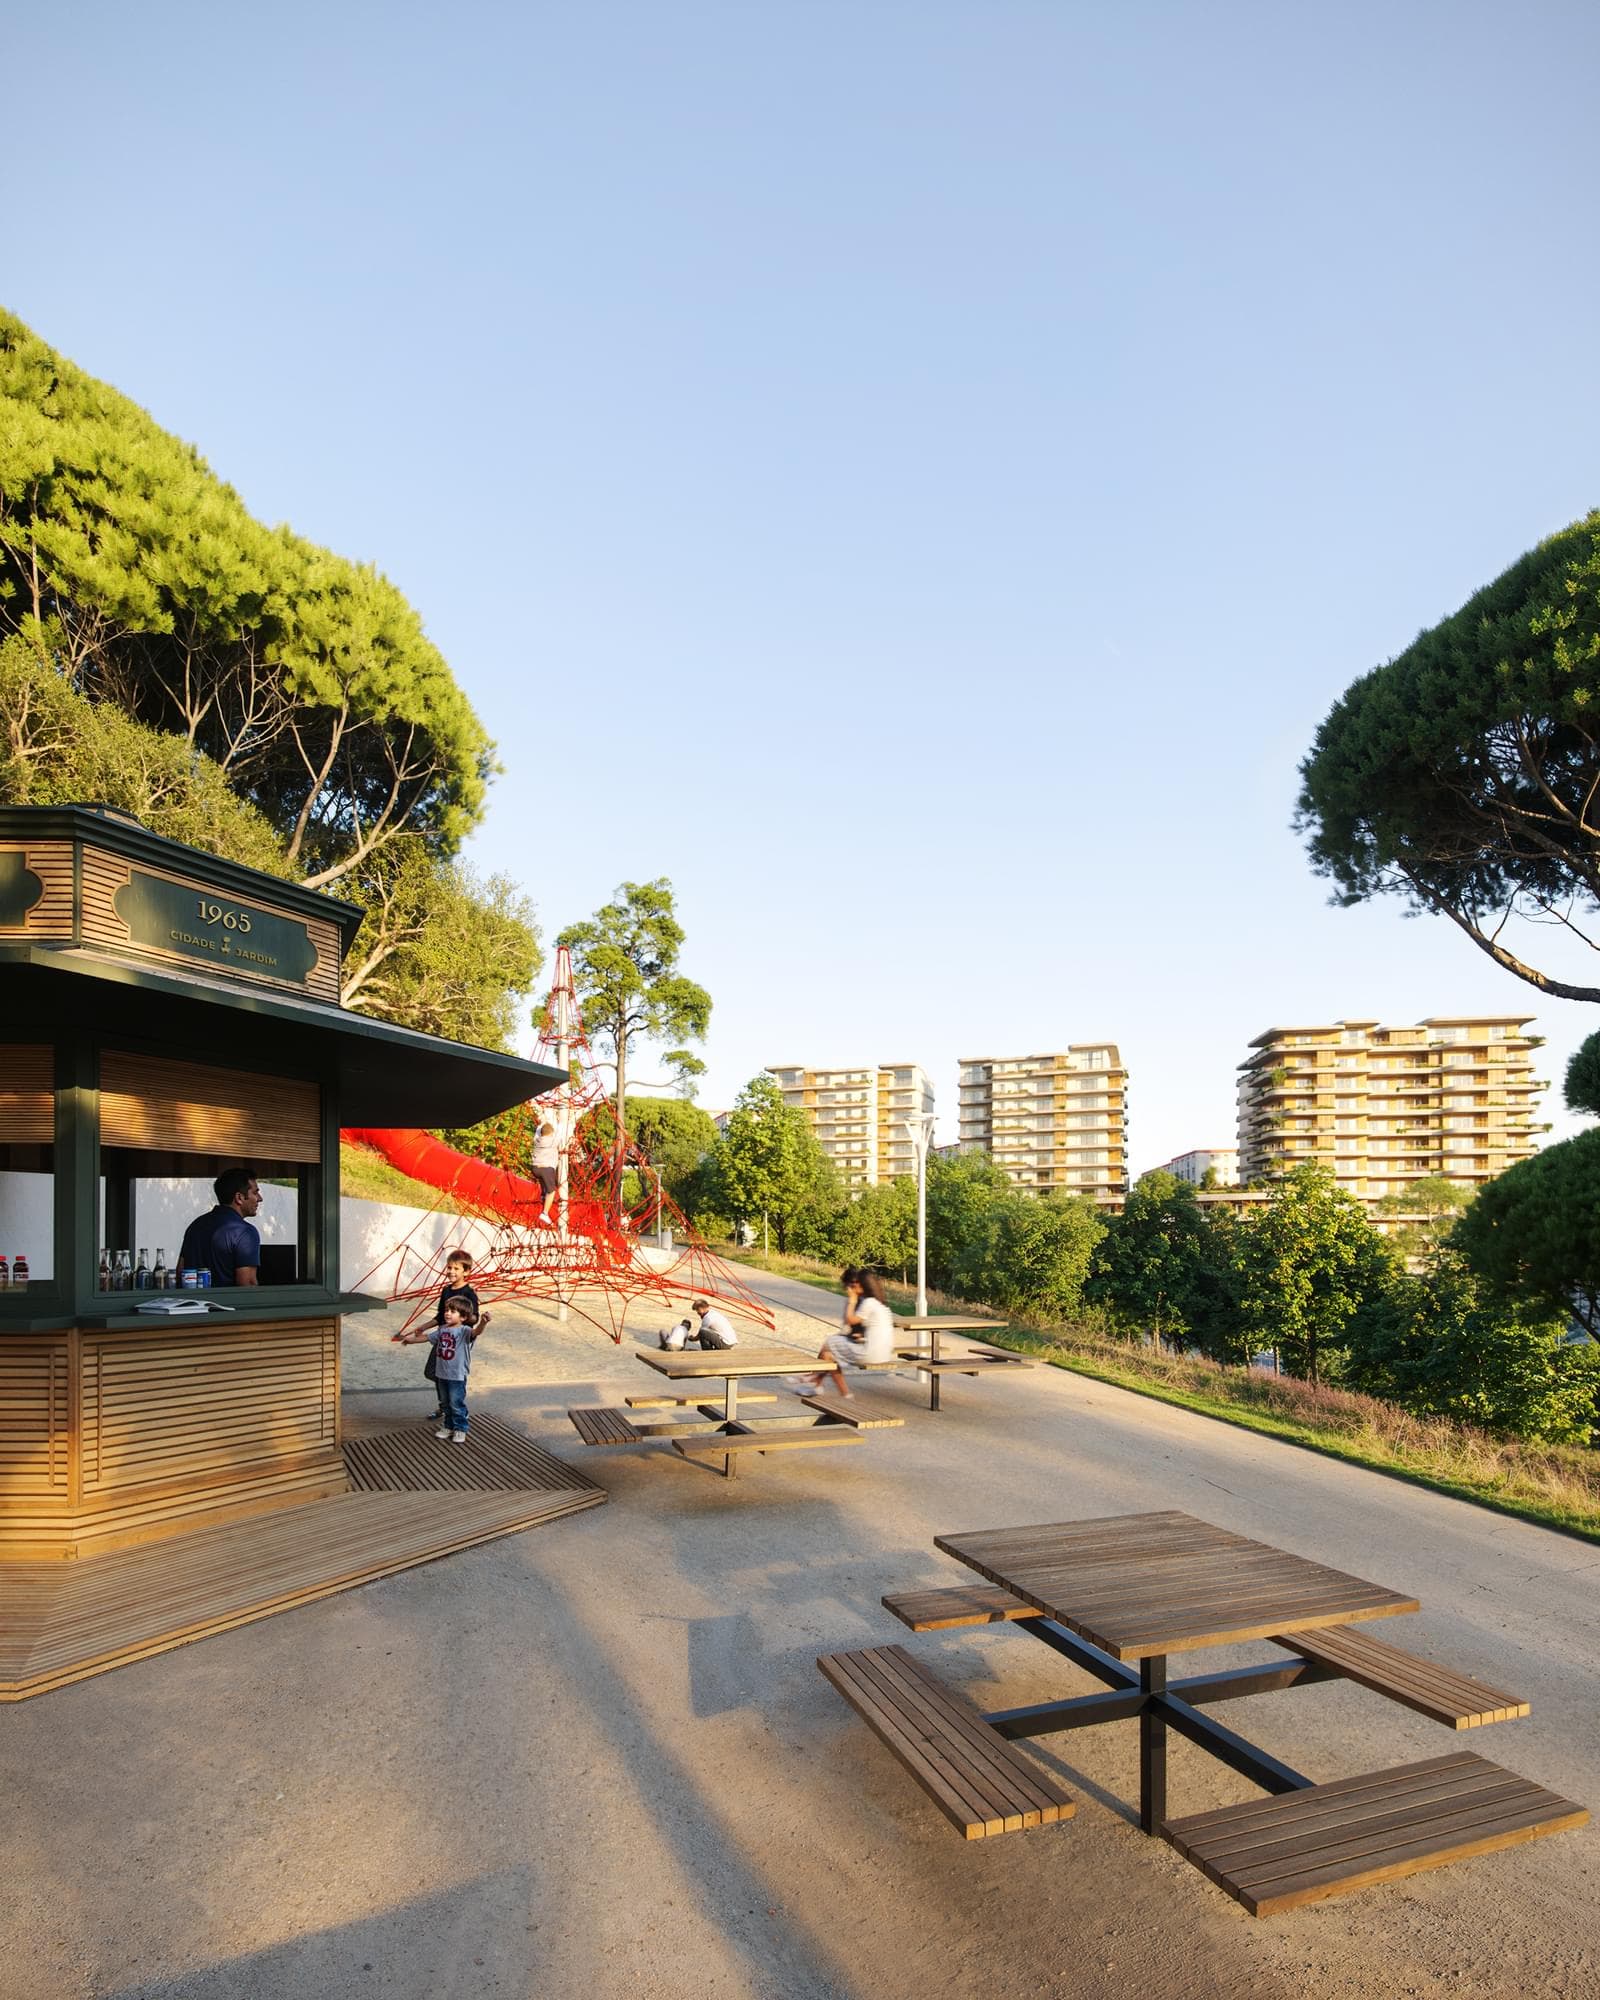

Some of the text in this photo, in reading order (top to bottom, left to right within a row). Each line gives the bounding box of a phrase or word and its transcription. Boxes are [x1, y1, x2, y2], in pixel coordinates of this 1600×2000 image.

[198, 901, 252, 933] 1965
[170, 930, 278, 966] CIDADE JARDIM
